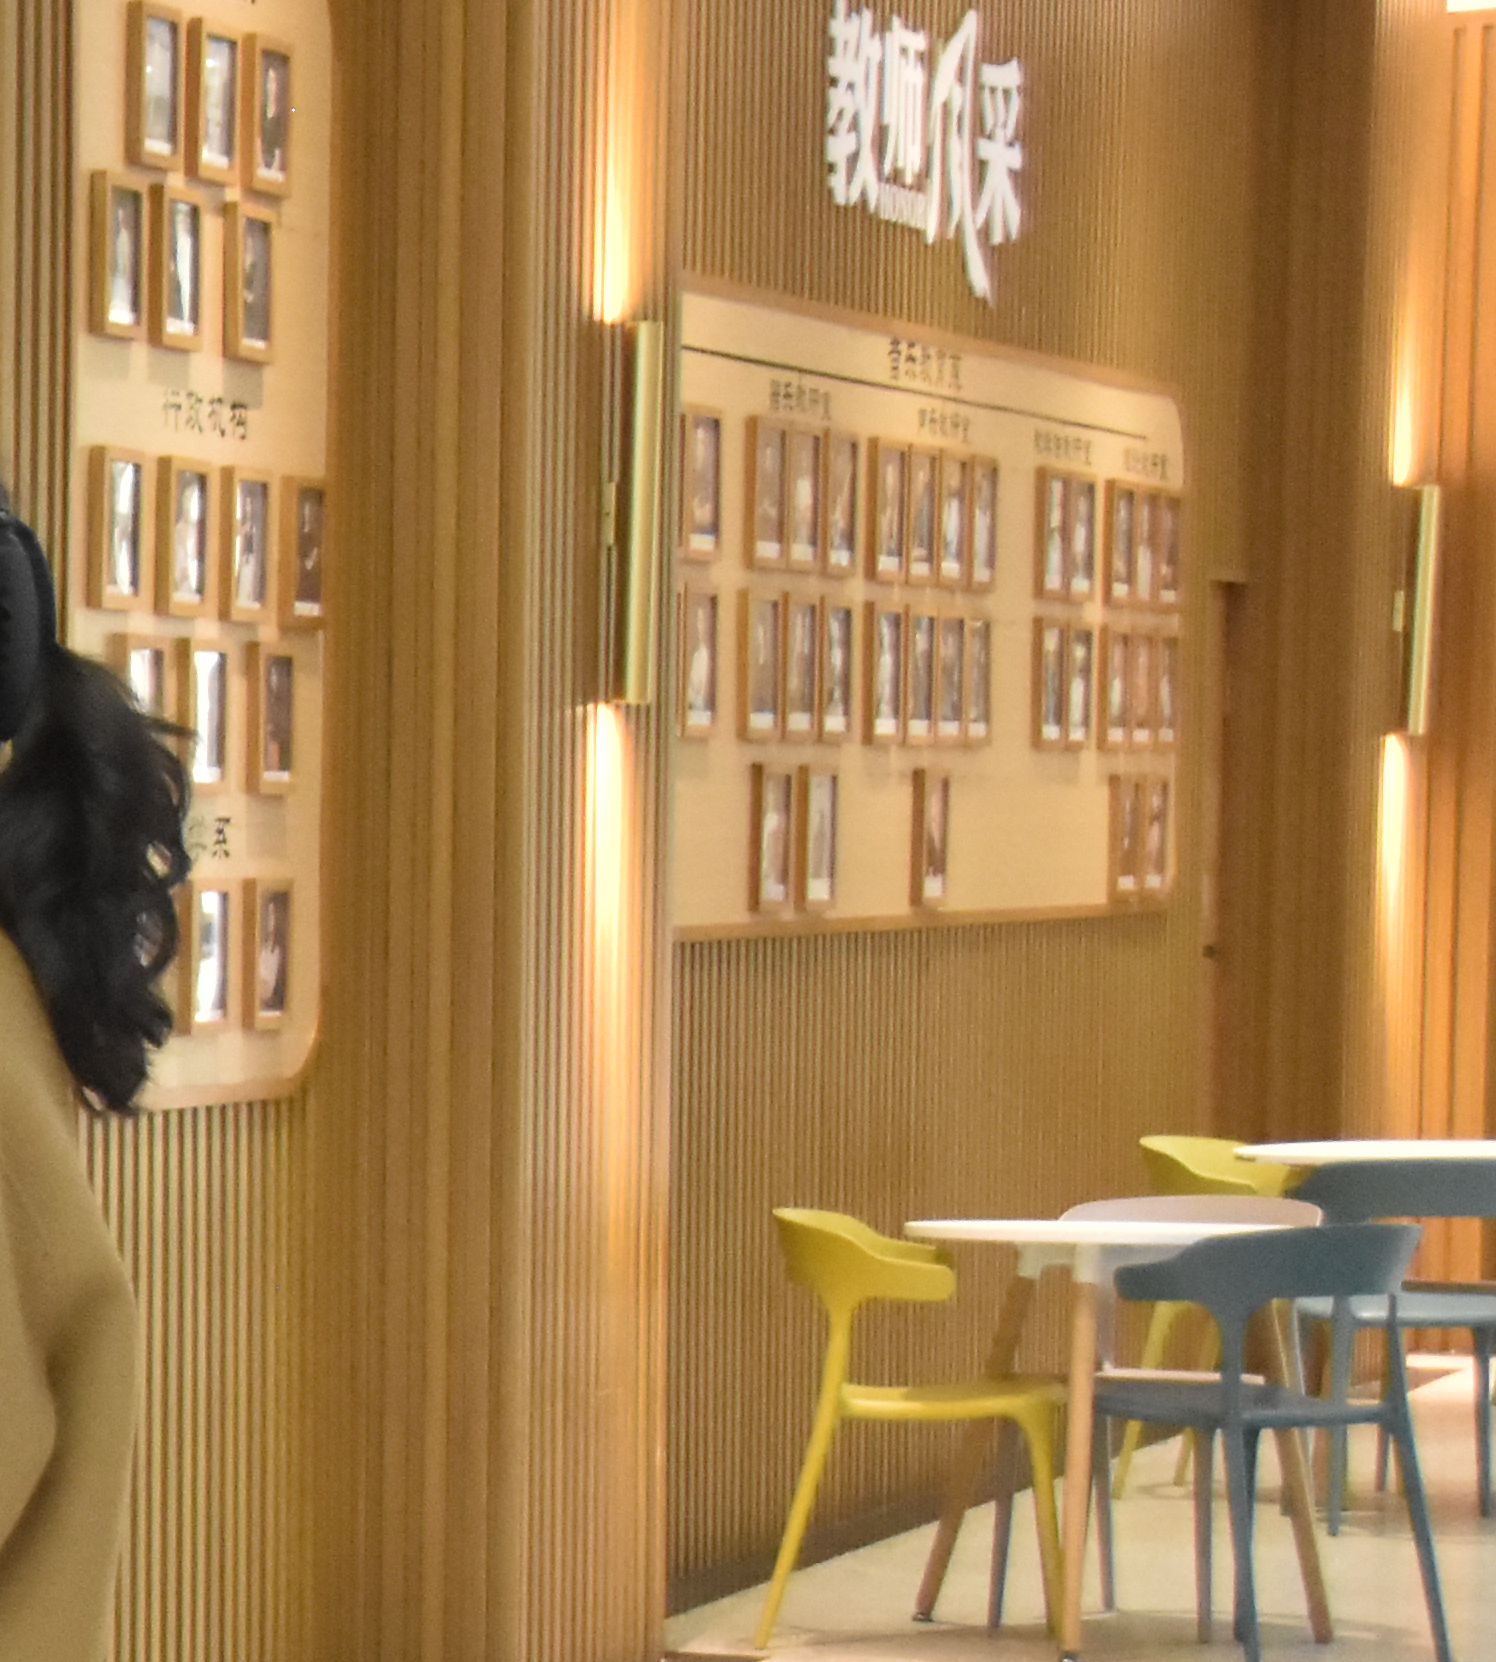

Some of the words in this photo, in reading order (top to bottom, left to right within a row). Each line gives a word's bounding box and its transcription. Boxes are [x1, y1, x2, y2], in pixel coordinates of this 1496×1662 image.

[826, 0, 1022, 311] 教师风采
[163, 385, 249, 441] 行政机构
